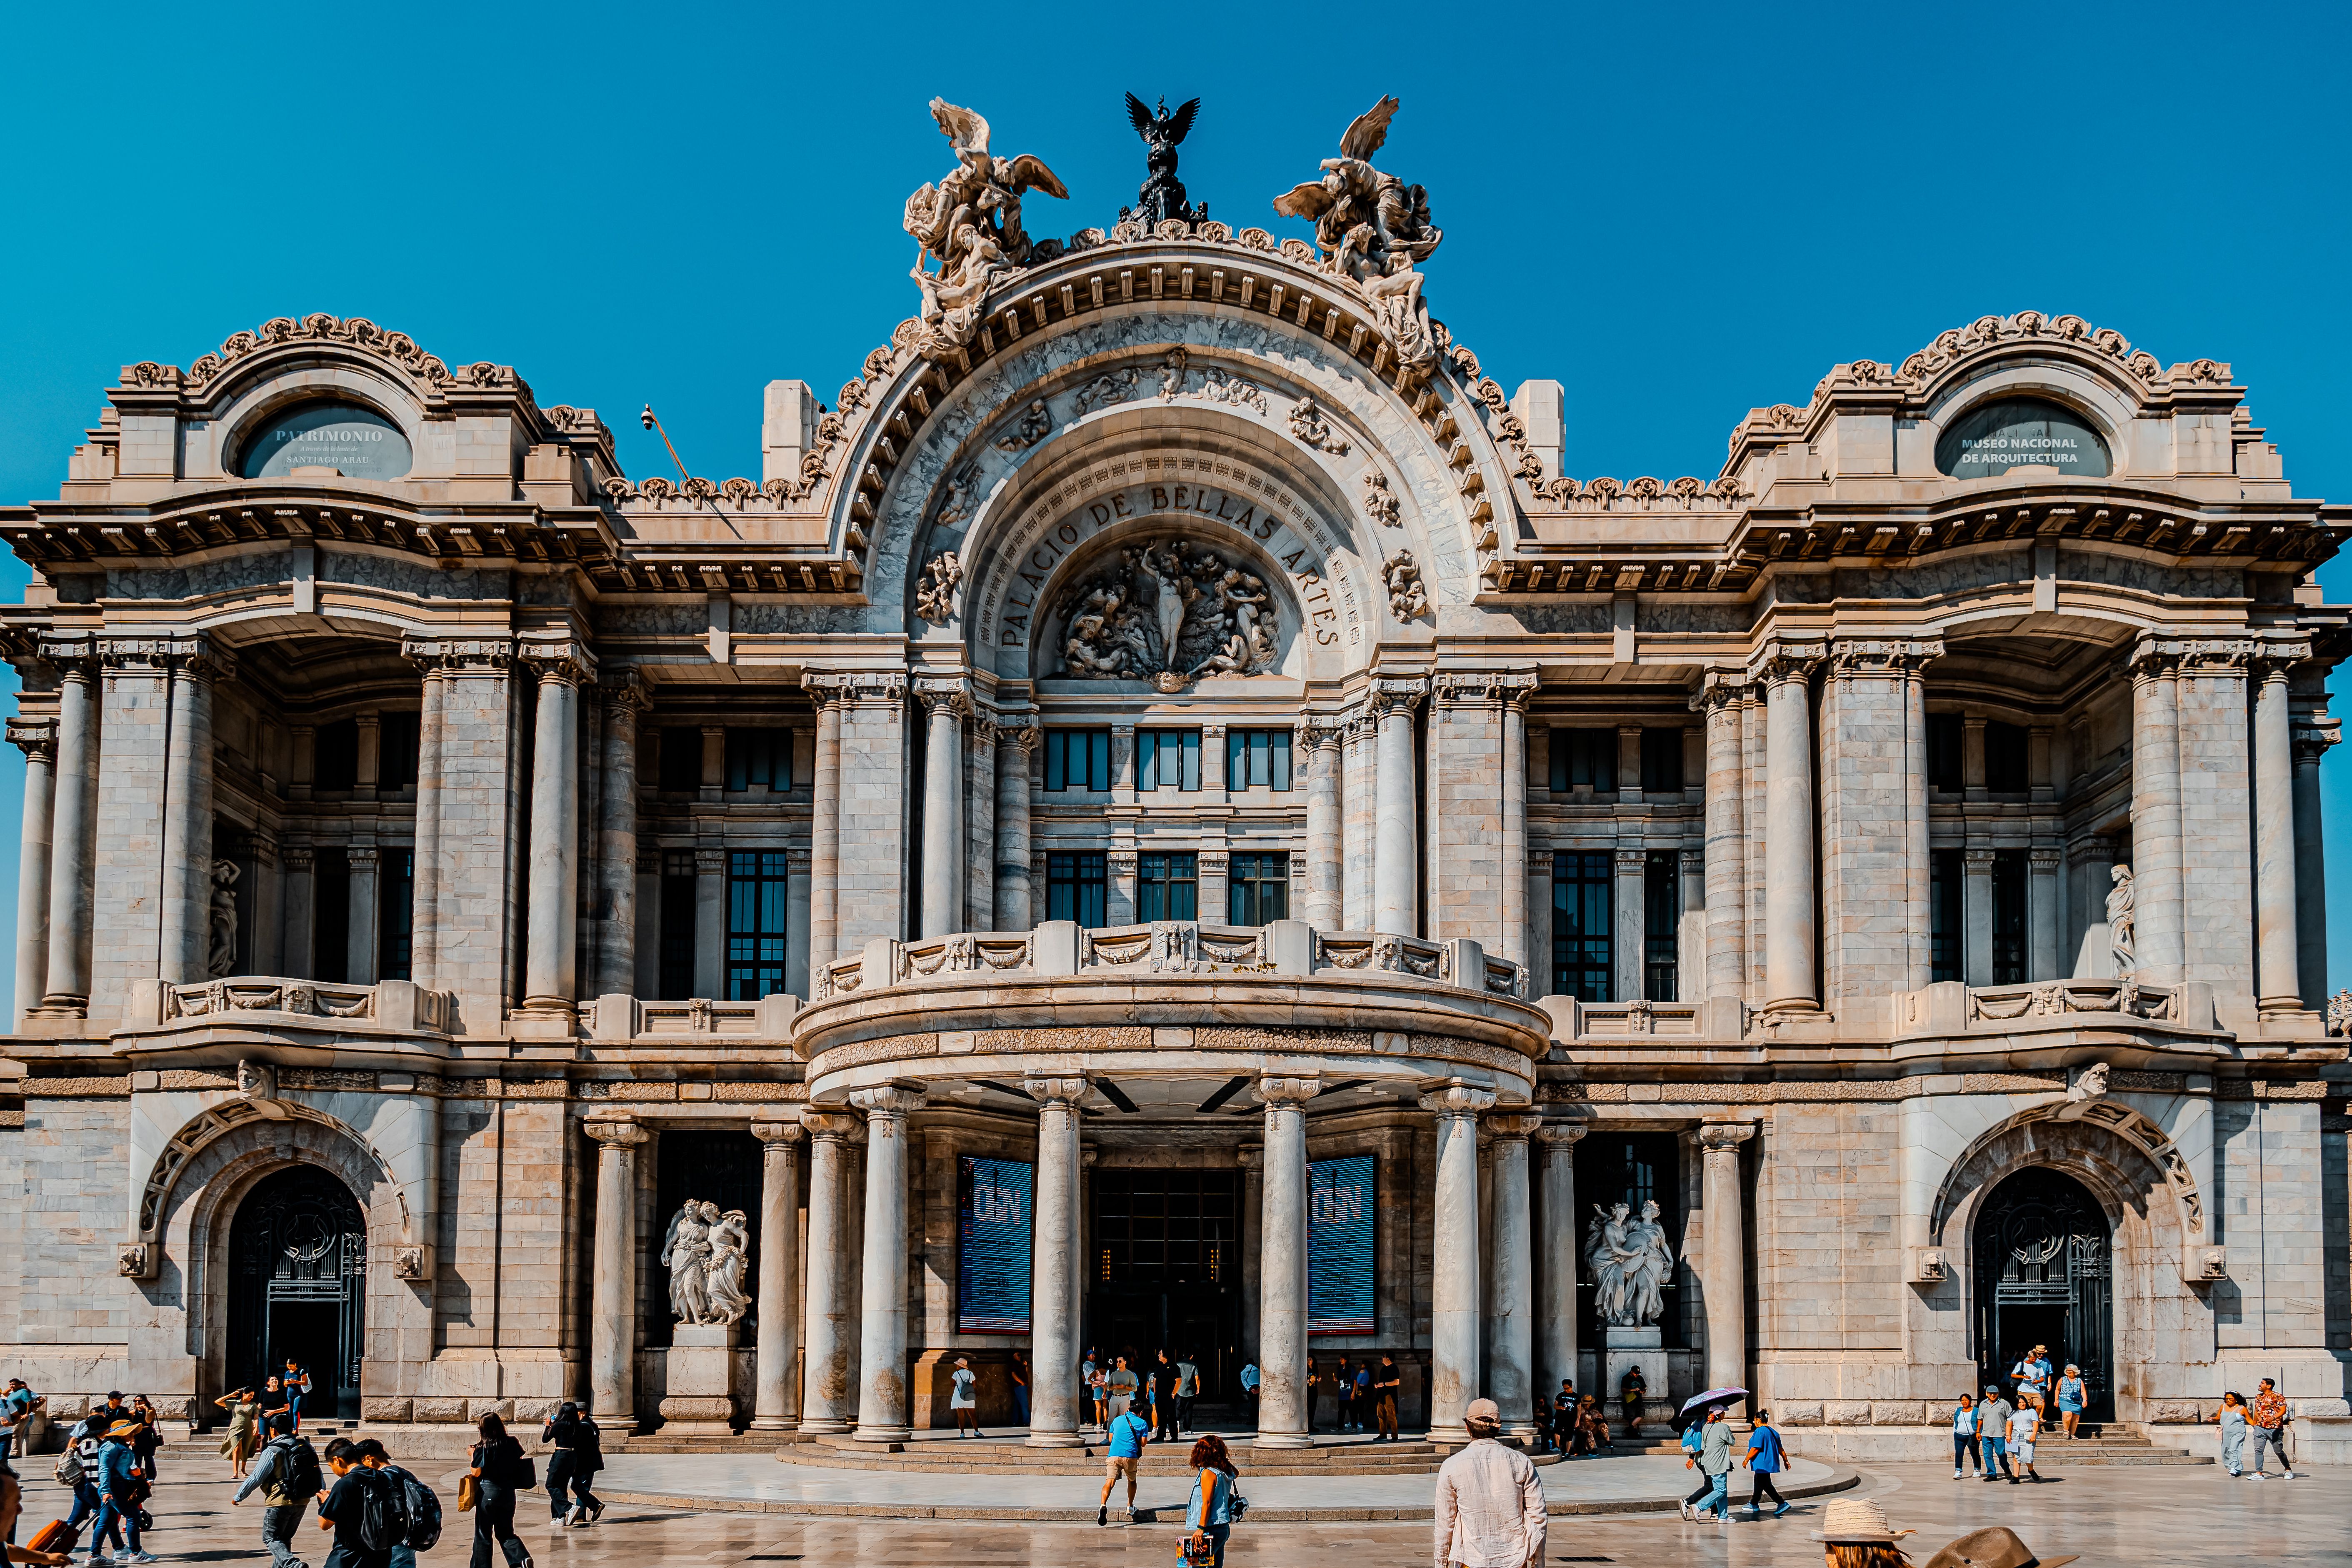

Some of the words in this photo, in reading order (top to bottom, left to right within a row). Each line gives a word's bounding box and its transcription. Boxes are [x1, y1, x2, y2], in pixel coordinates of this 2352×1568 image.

[276, 430, 382, 442] PATRIMONIO
[1962, 439, 2008, 449] MUSEO
[2011, 439, 2077, 448] NACIONAL
[1962, 453, 1980, 463] DE
[1981, 453, 2078, 464] ARQUITECTURA
[1002, 525, 1078, 648] PALACIO
[1089, 493, 1133, 527] DE
[1150, 486, 1275, 540] BELLAS
[1281, 547, 1339, 647] ARTES
